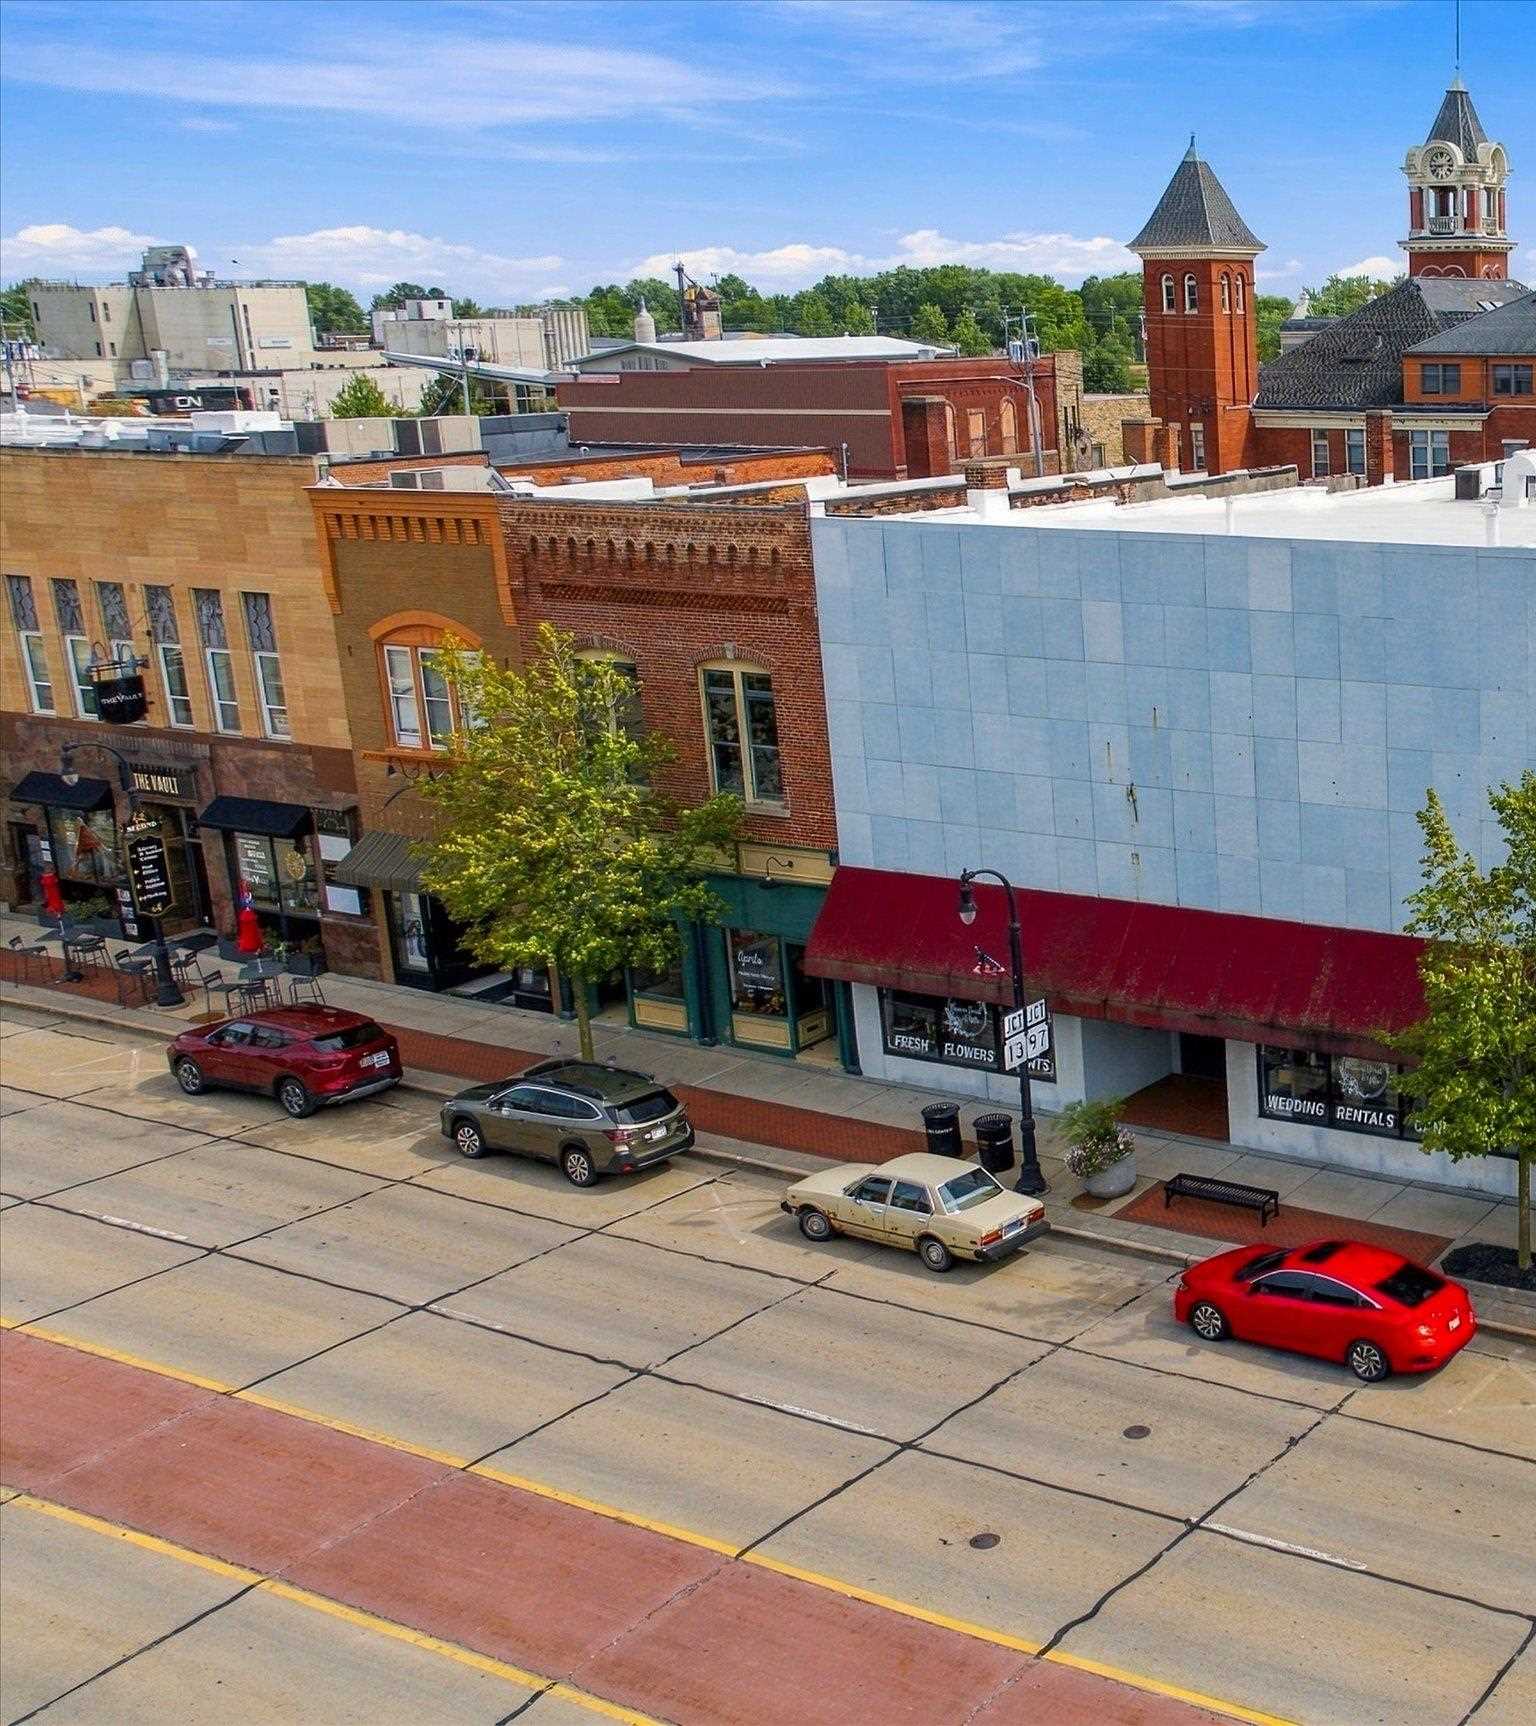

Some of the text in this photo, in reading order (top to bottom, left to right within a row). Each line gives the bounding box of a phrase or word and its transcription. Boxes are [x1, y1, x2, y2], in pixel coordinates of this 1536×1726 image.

[175, 395, 202, 408] CN
[133, 772, 179, 794] THE VAULT
[1007, 1012, 1022, 1035] JCT
[1029, 1003, 1044, 1024] JCT
[895, 1034, 929, 1052] FRESH
[944, 1043, 994, 1063] FLOWERS
[1029, 1030, 1046, 1050] 97
[1008, 1041, 1024, 1063] 13
[1267, 1095, 1325, 1117] WEDDING
[1336, 1106, 1395, 1128] RENTALS
